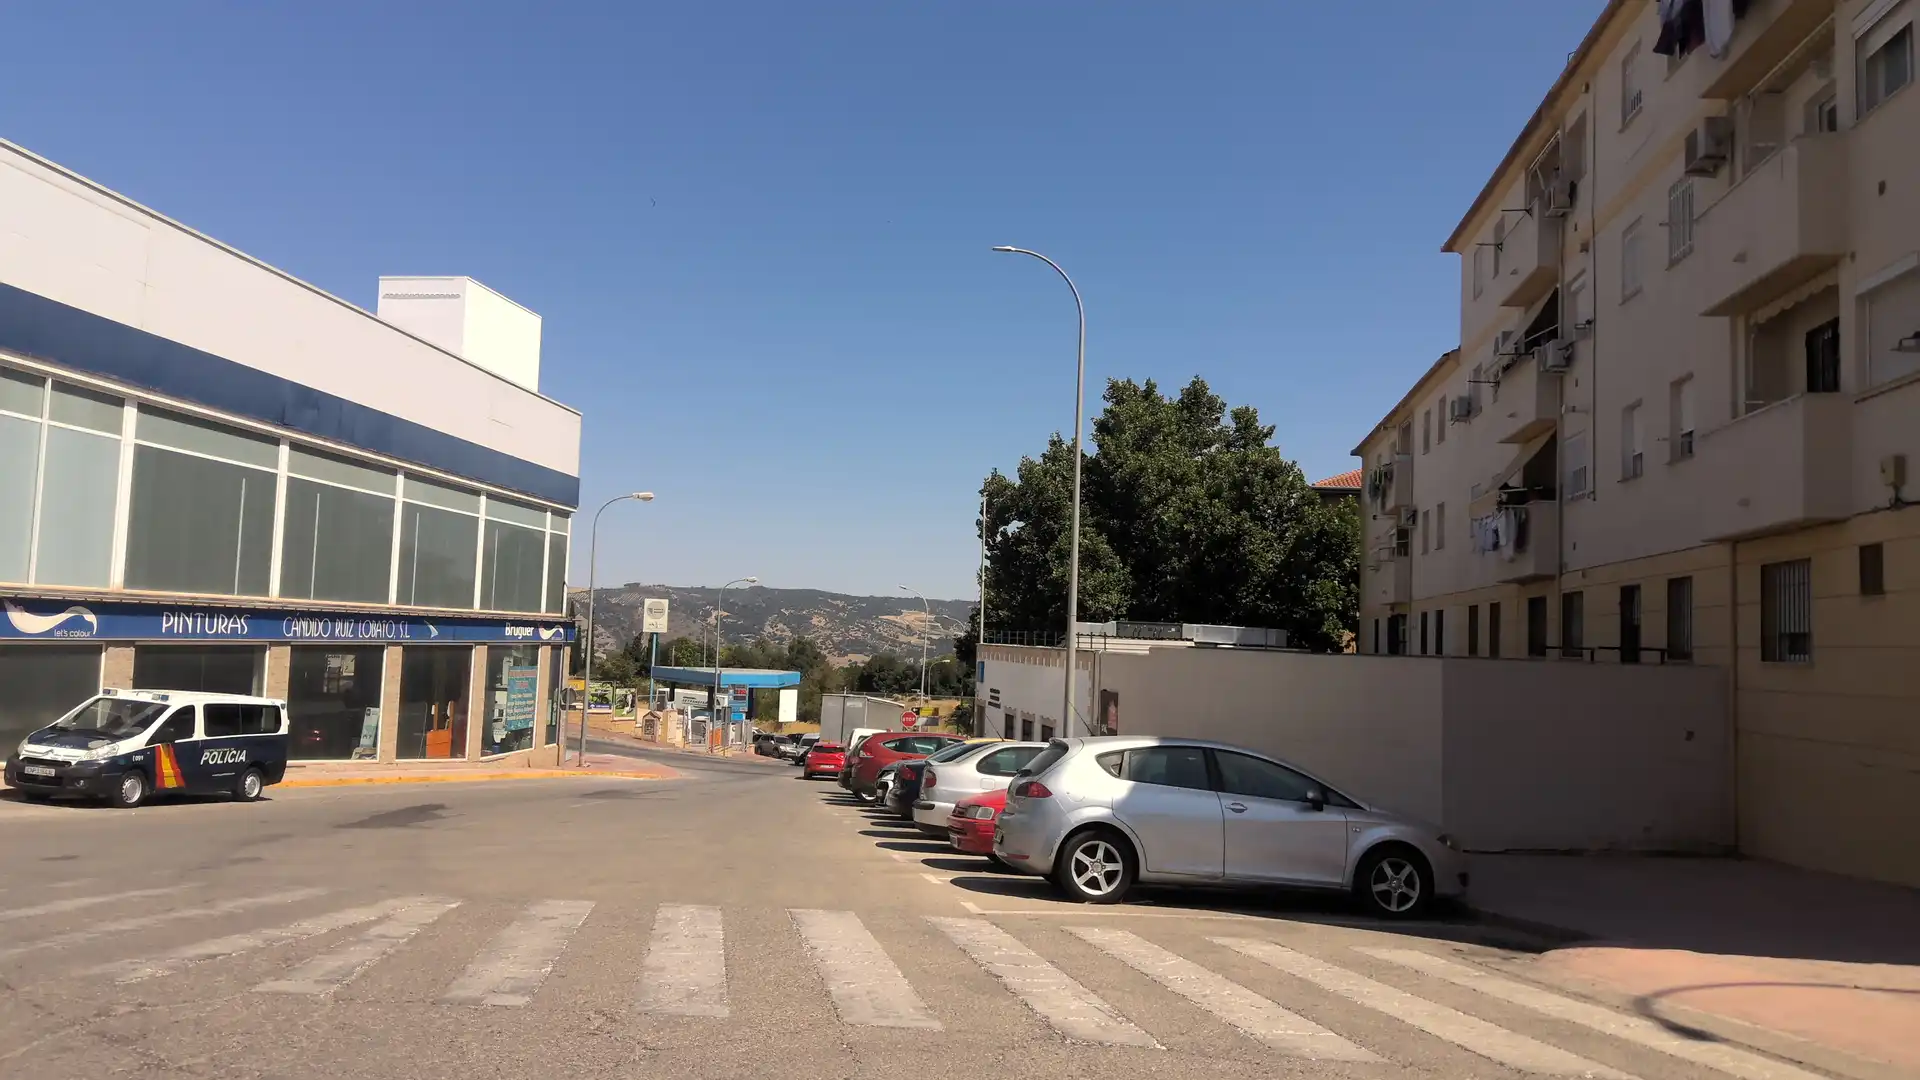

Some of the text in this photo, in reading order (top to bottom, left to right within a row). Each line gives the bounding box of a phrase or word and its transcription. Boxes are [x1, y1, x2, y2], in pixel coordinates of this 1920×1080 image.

[162, 611, 250, 635] PINTURAS
[283, 612, 331, 637] CÁNDIDO
[335, 618, 355, 638] RUIZ
[505, 622, 534, 639] Bruguer
[54, 629, 92, 638] let's colour
